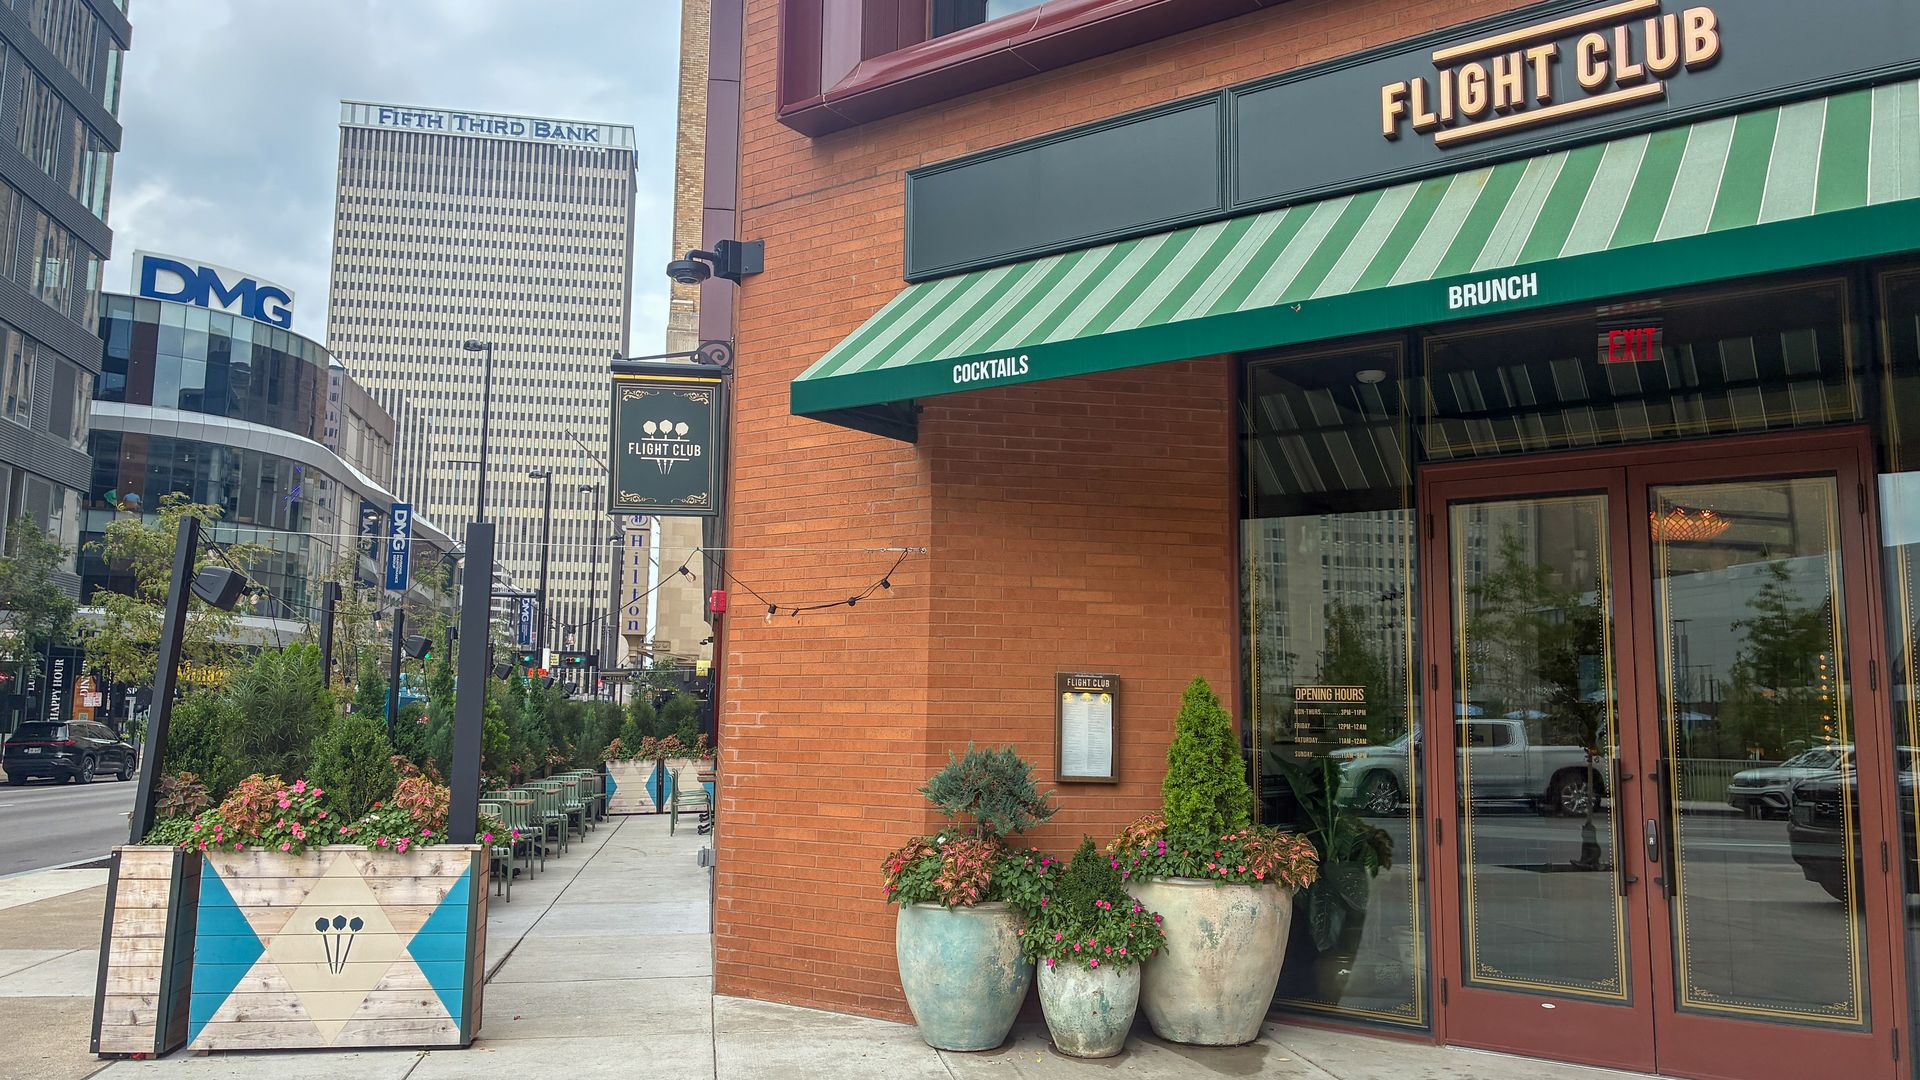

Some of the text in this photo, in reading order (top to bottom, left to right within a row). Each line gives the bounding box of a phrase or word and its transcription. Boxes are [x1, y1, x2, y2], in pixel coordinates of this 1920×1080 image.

[1381, 7, 1719, 139] FLIGHT CLUB
[378, 108, 598, 142] FIFTH THIRD BANK
[140, 255, 292, 329] DMG
[1448, 273, 1538, 309] BRUNCH
[1608, 328, 1656, 363] EXIT
[953, 354, 1029, 384] COCKTAILS
[628, 442, 701, 457] FLIGHT CLUB
[392, 510, 407, 551] DMG
[626, 534, 645, 631] Hilton
[49, 658, 65, 721] HAPPY HOUR
[1067, 678, 1110, 688] FLIGHT CLUB
[1295, 687, 1364, 701] OPENING HOURS
